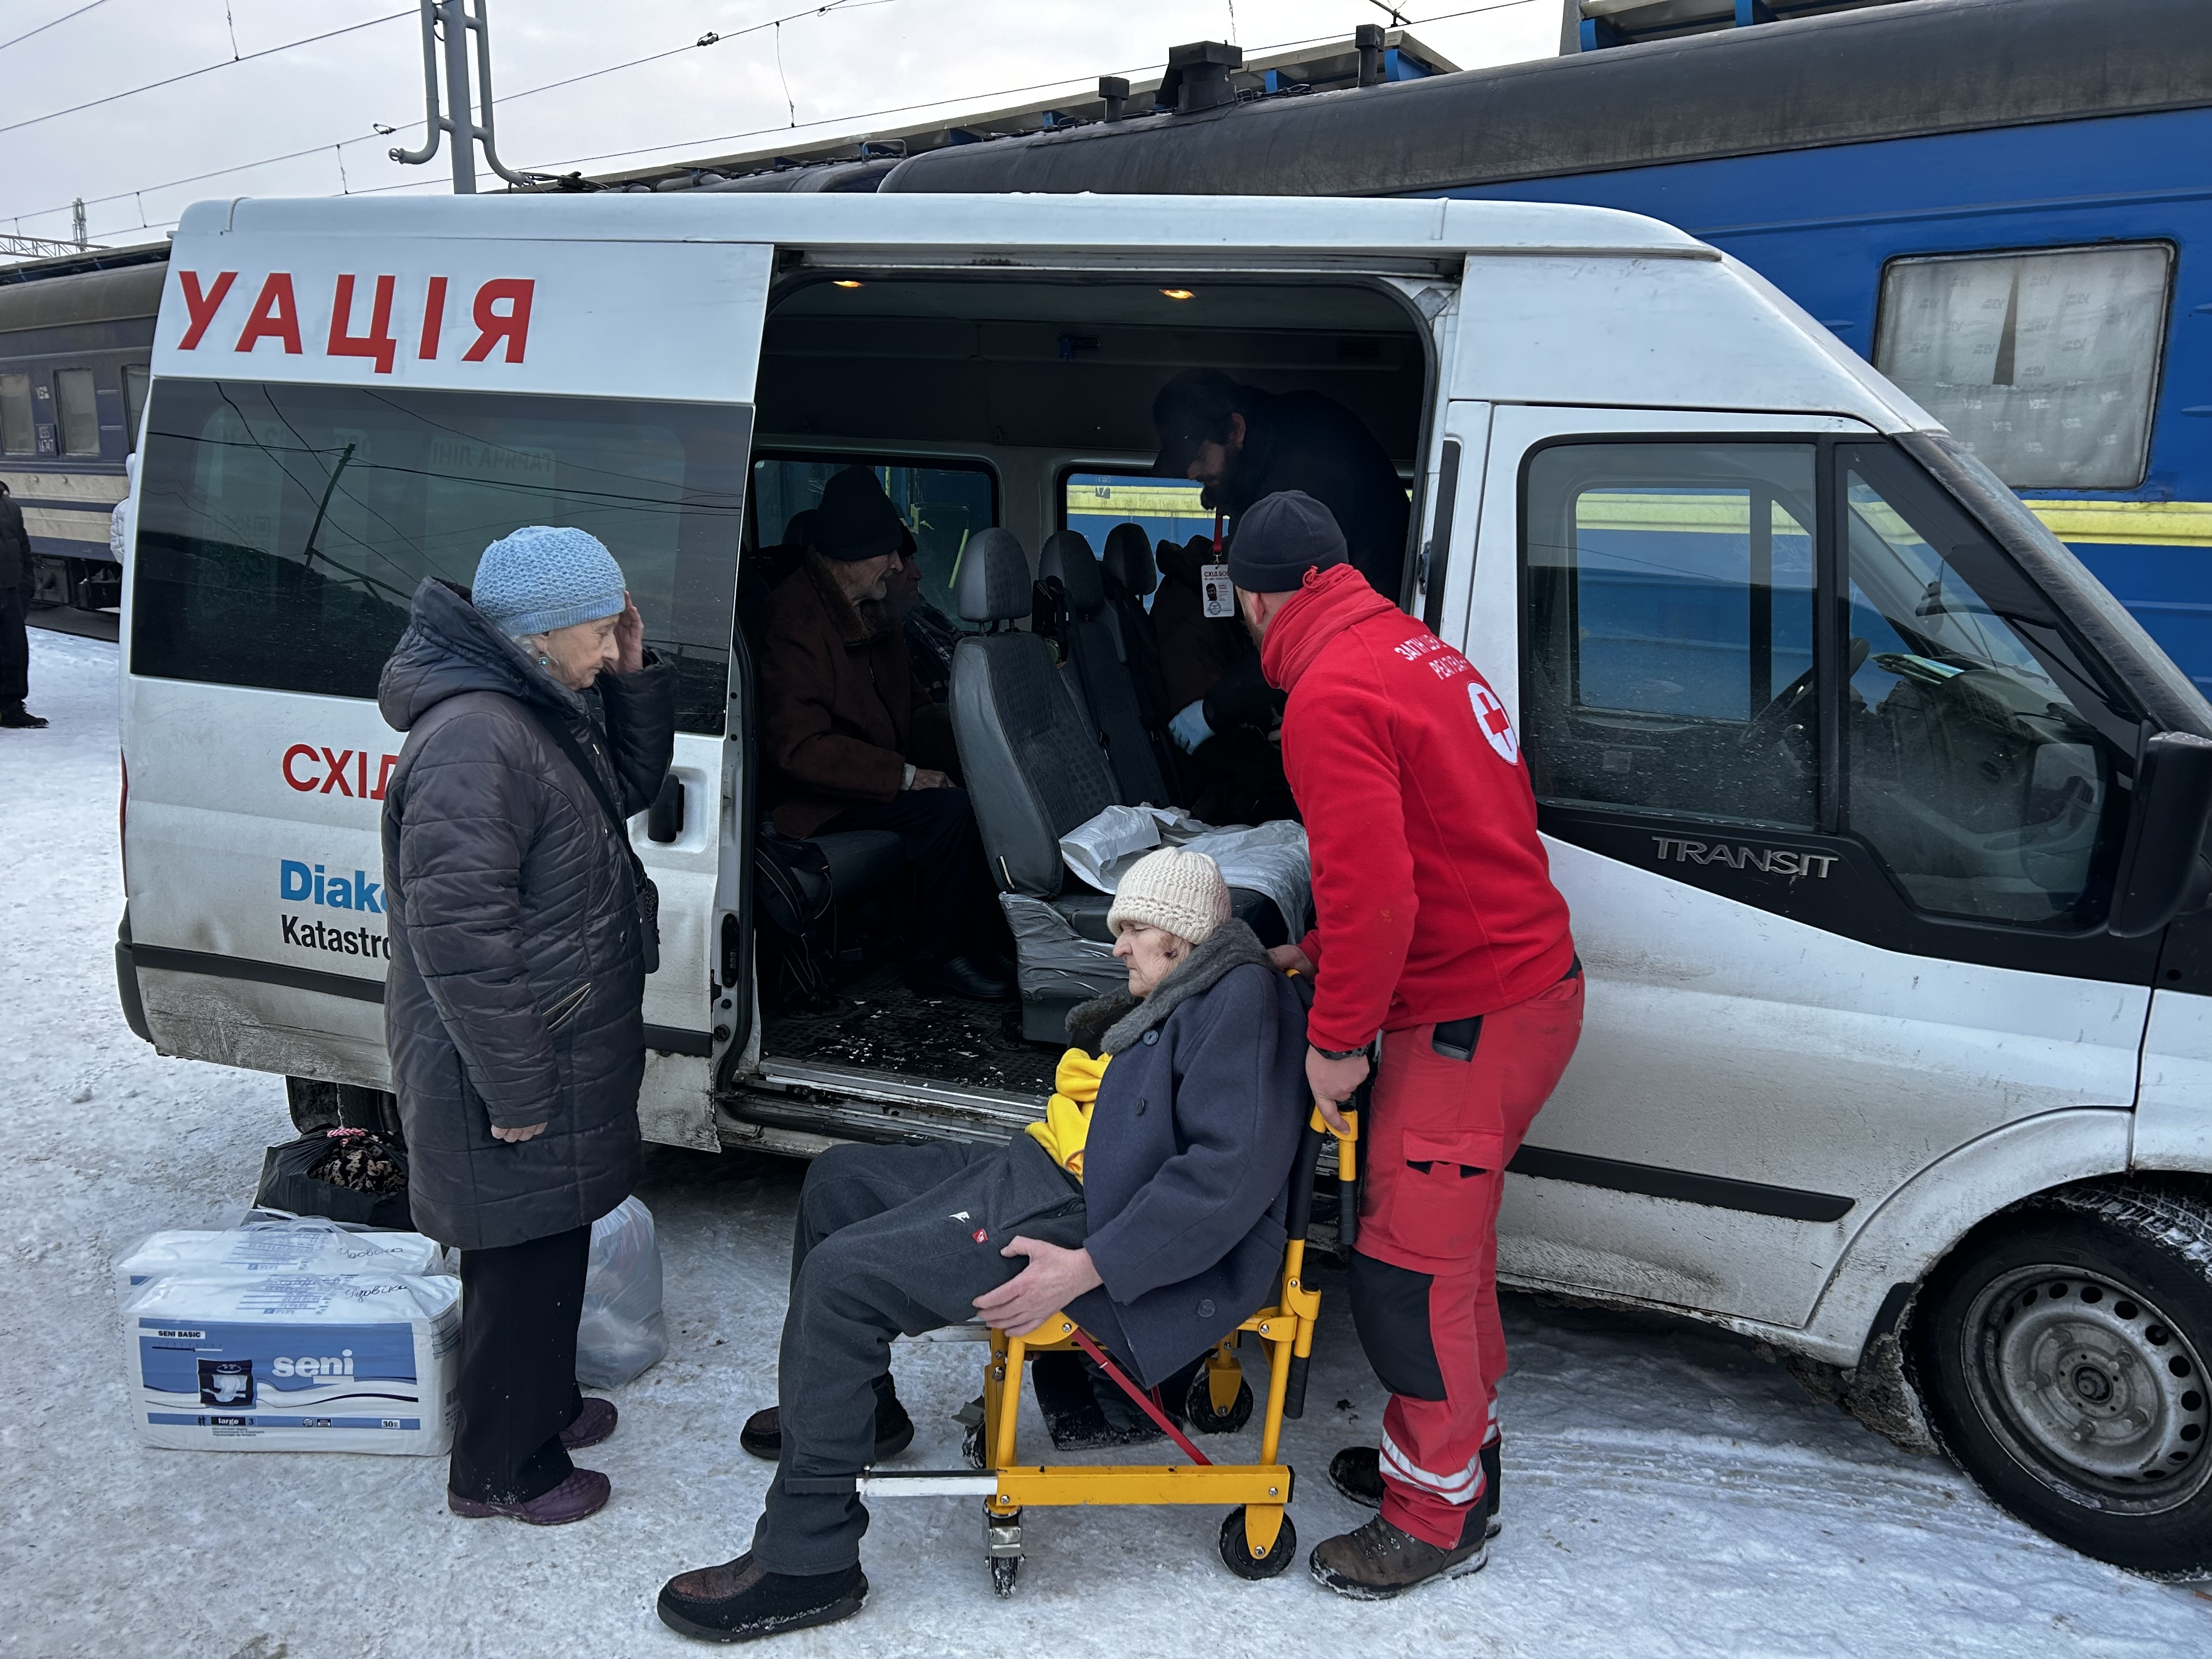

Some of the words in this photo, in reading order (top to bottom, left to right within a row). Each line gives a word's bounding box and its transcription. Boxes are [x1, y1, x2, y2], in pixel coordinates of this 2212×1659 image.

[177, 270, 535, 374] УАЦІЯ
[1651, 836, 1839, 878] TRANSIT
[280, 859, 387, 914] Diak
[272, 1349, 354, 1378] seni
